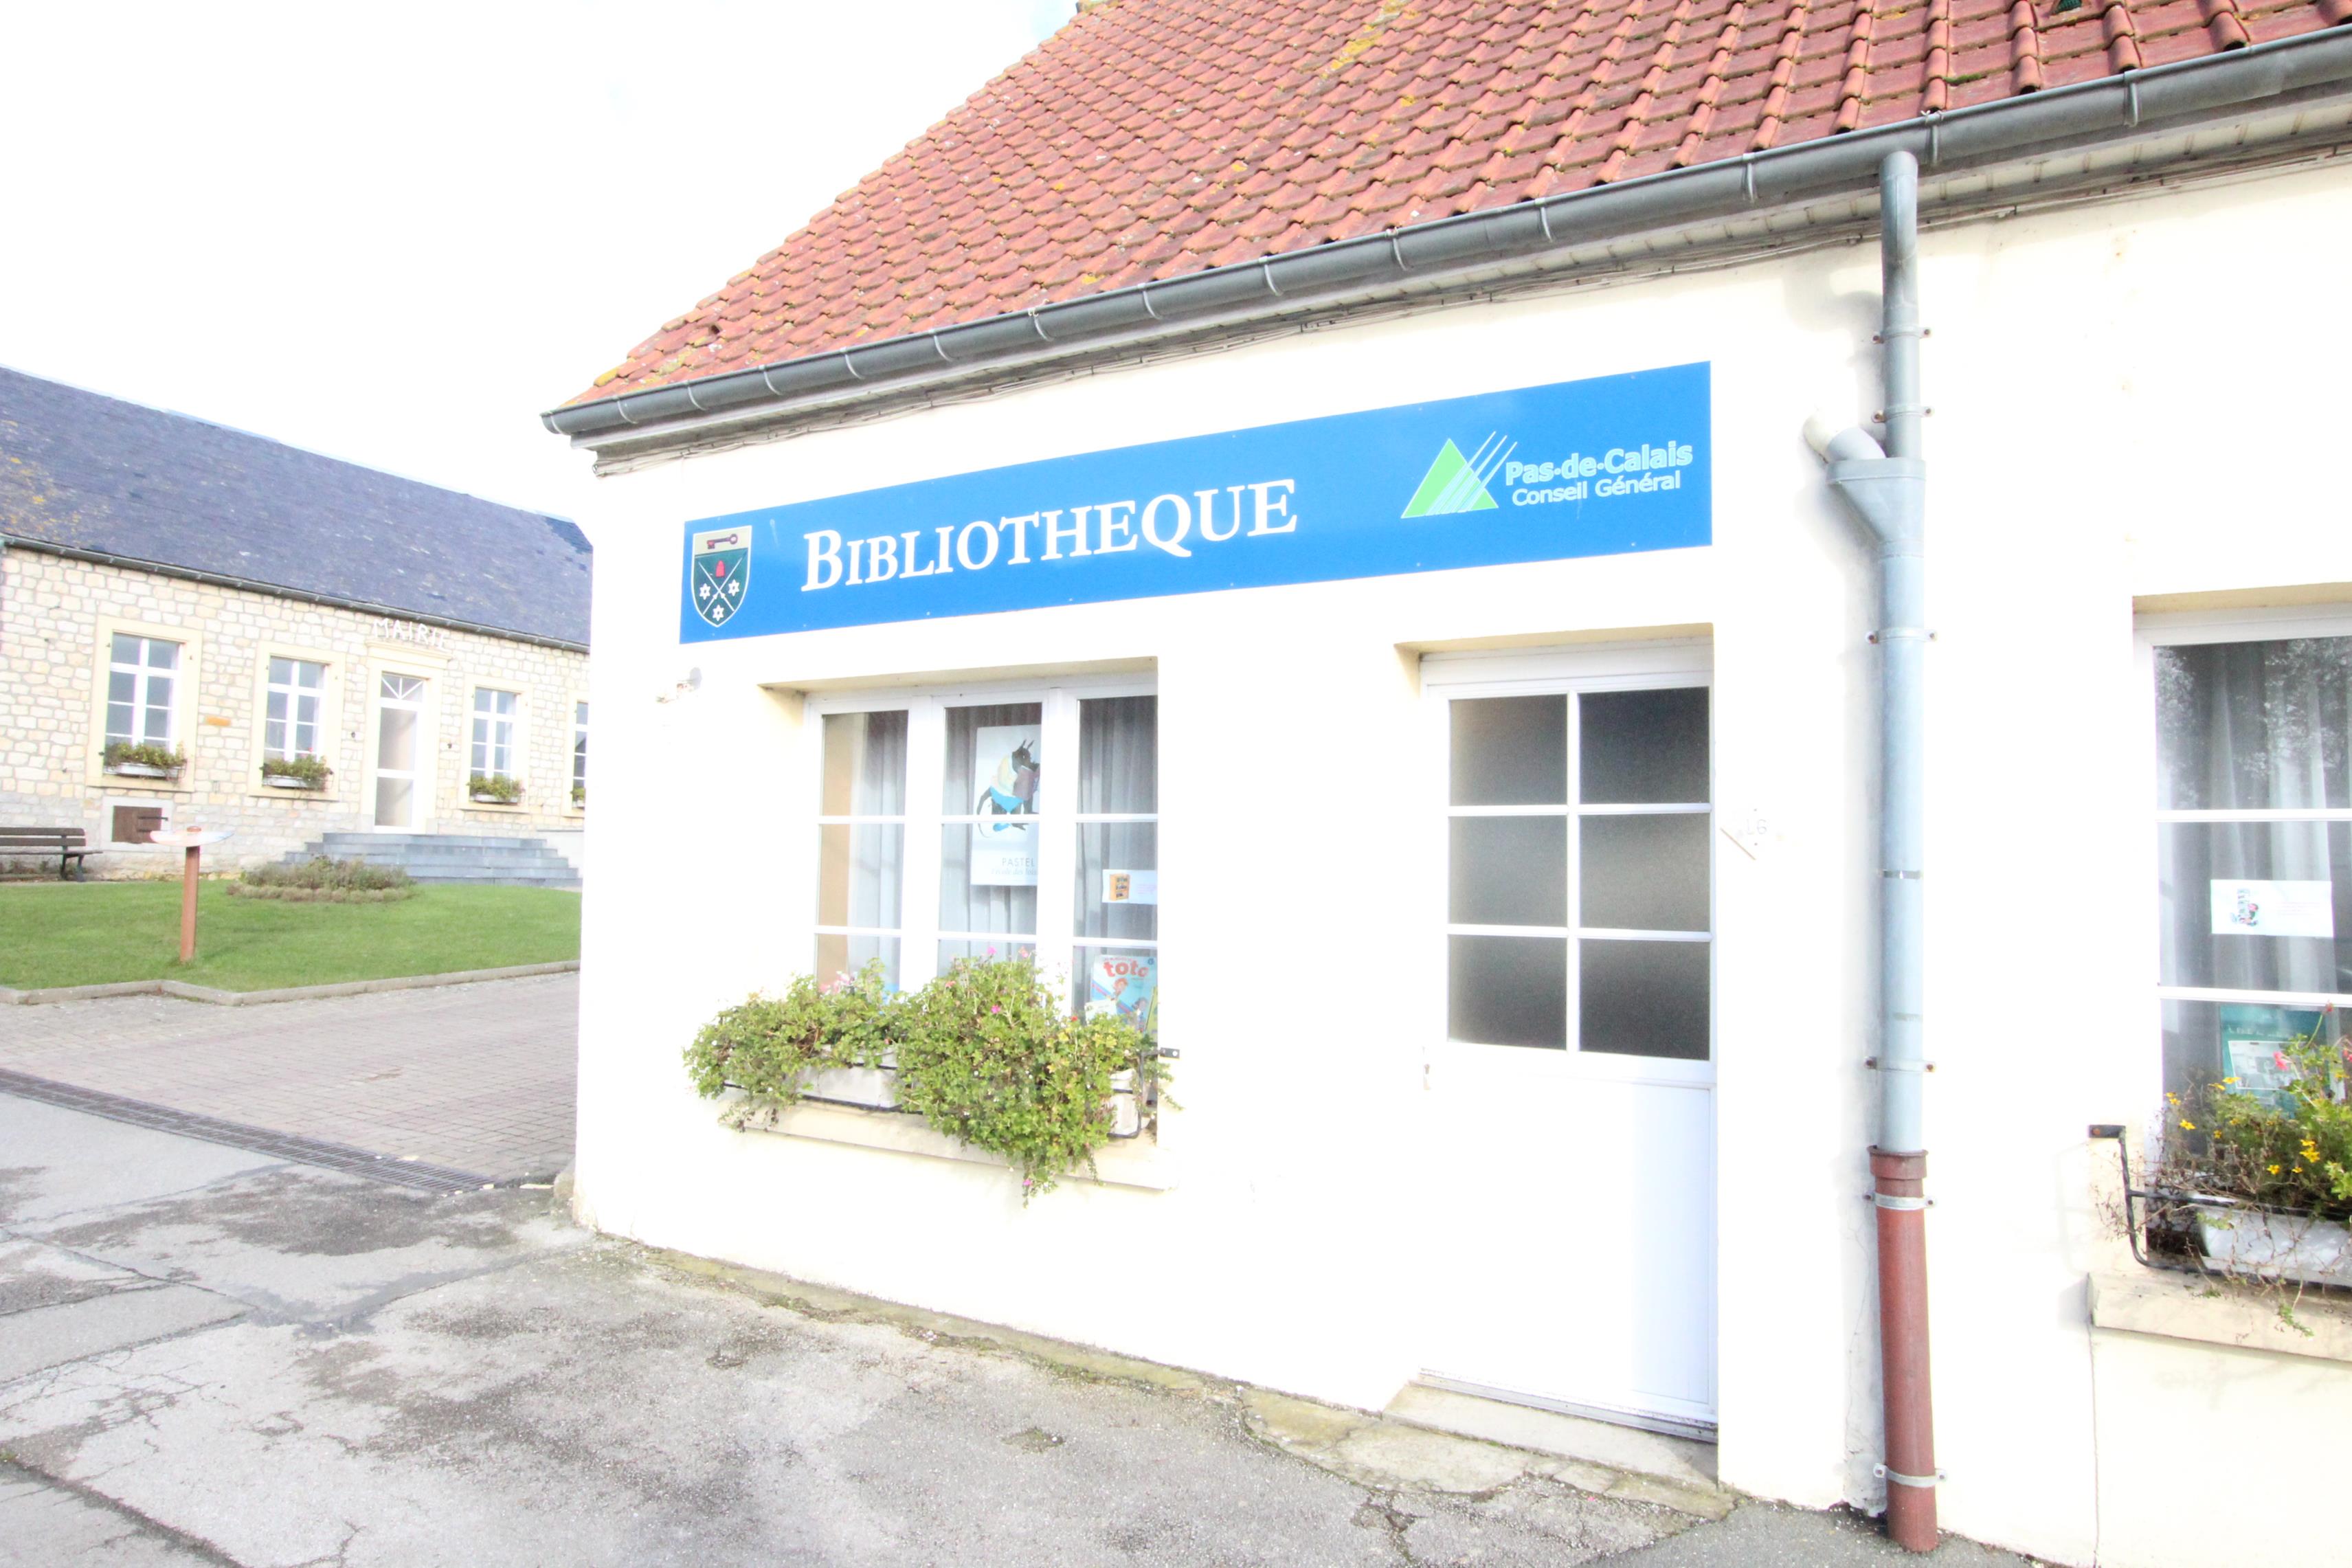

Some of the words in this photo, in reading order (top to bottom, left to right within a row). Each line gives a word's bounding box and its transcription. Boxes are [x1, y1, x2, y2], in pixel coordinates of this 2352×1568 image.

[1512, 481, 1587, 506] Conseil
[1595, 470, 1681, 497] Général
[801, 479, 1297, 592] BIBLIOTHEQUE
[373, 618, 452, 652] MAIRIE
[1002, 857, 1035, 867] PASTEL
